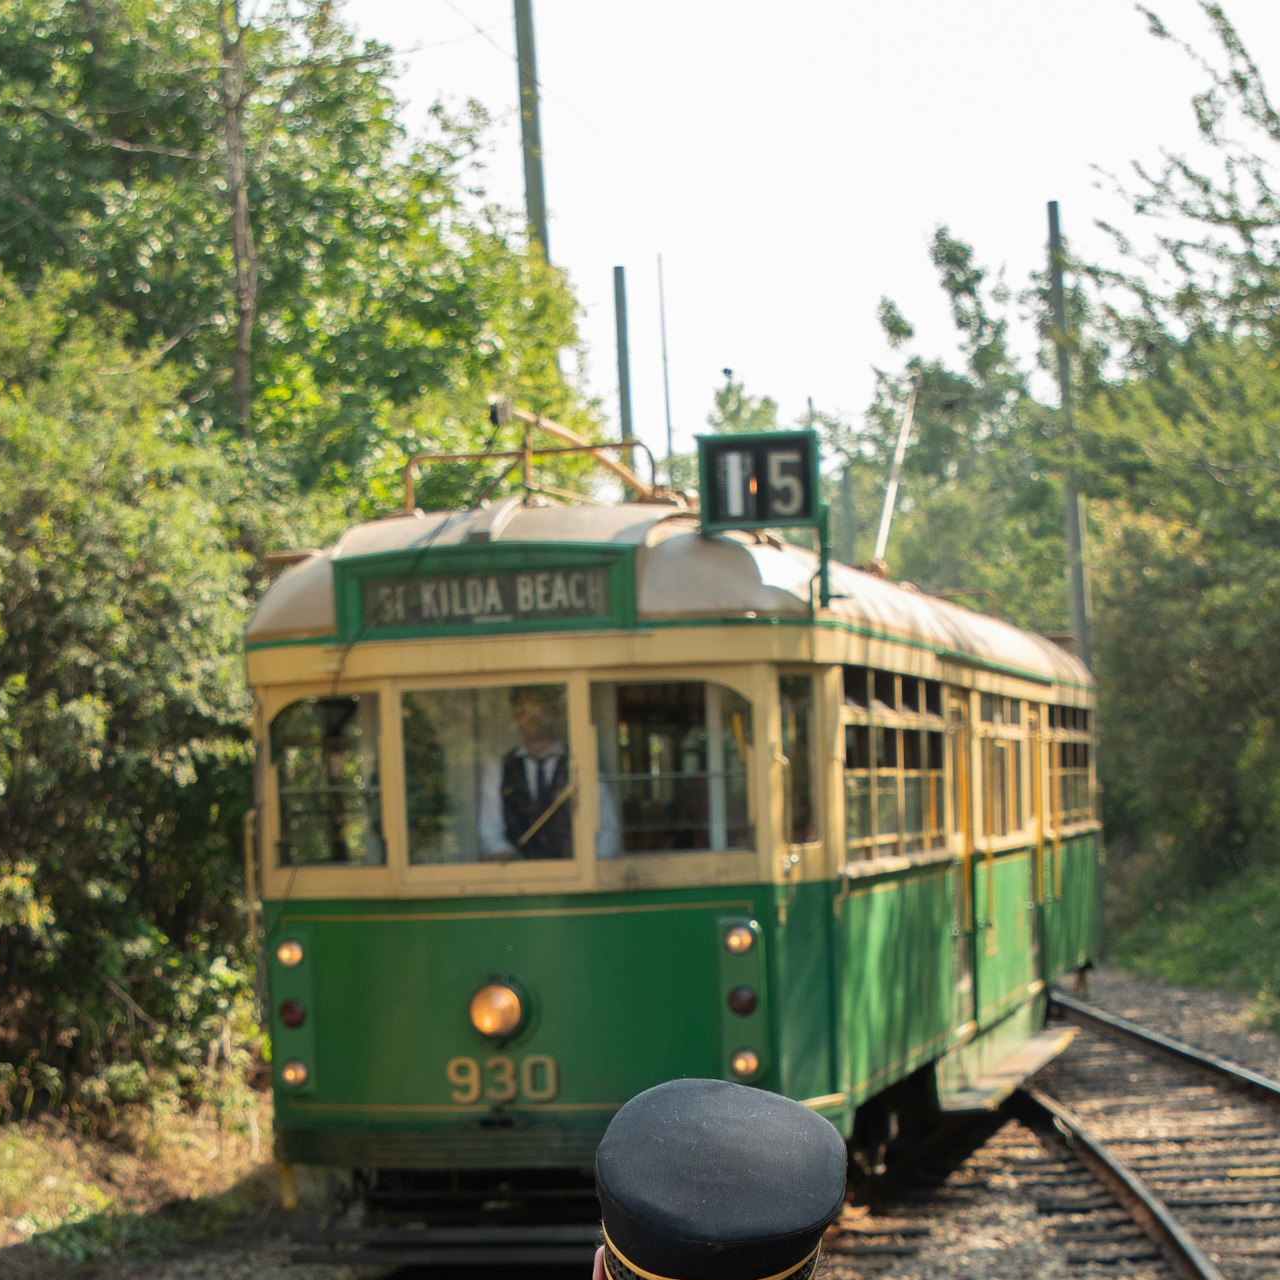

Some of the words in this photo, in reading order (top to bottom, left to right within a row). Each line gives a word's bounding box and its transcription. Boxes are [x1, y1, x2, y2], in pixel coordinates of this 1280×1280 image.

[726, 451, 804, 517] 15
[421, 575, 504, 619] KILDA
[516, 570, 606, 613] BEACH
[446, 1055, 558, 1103] 930
